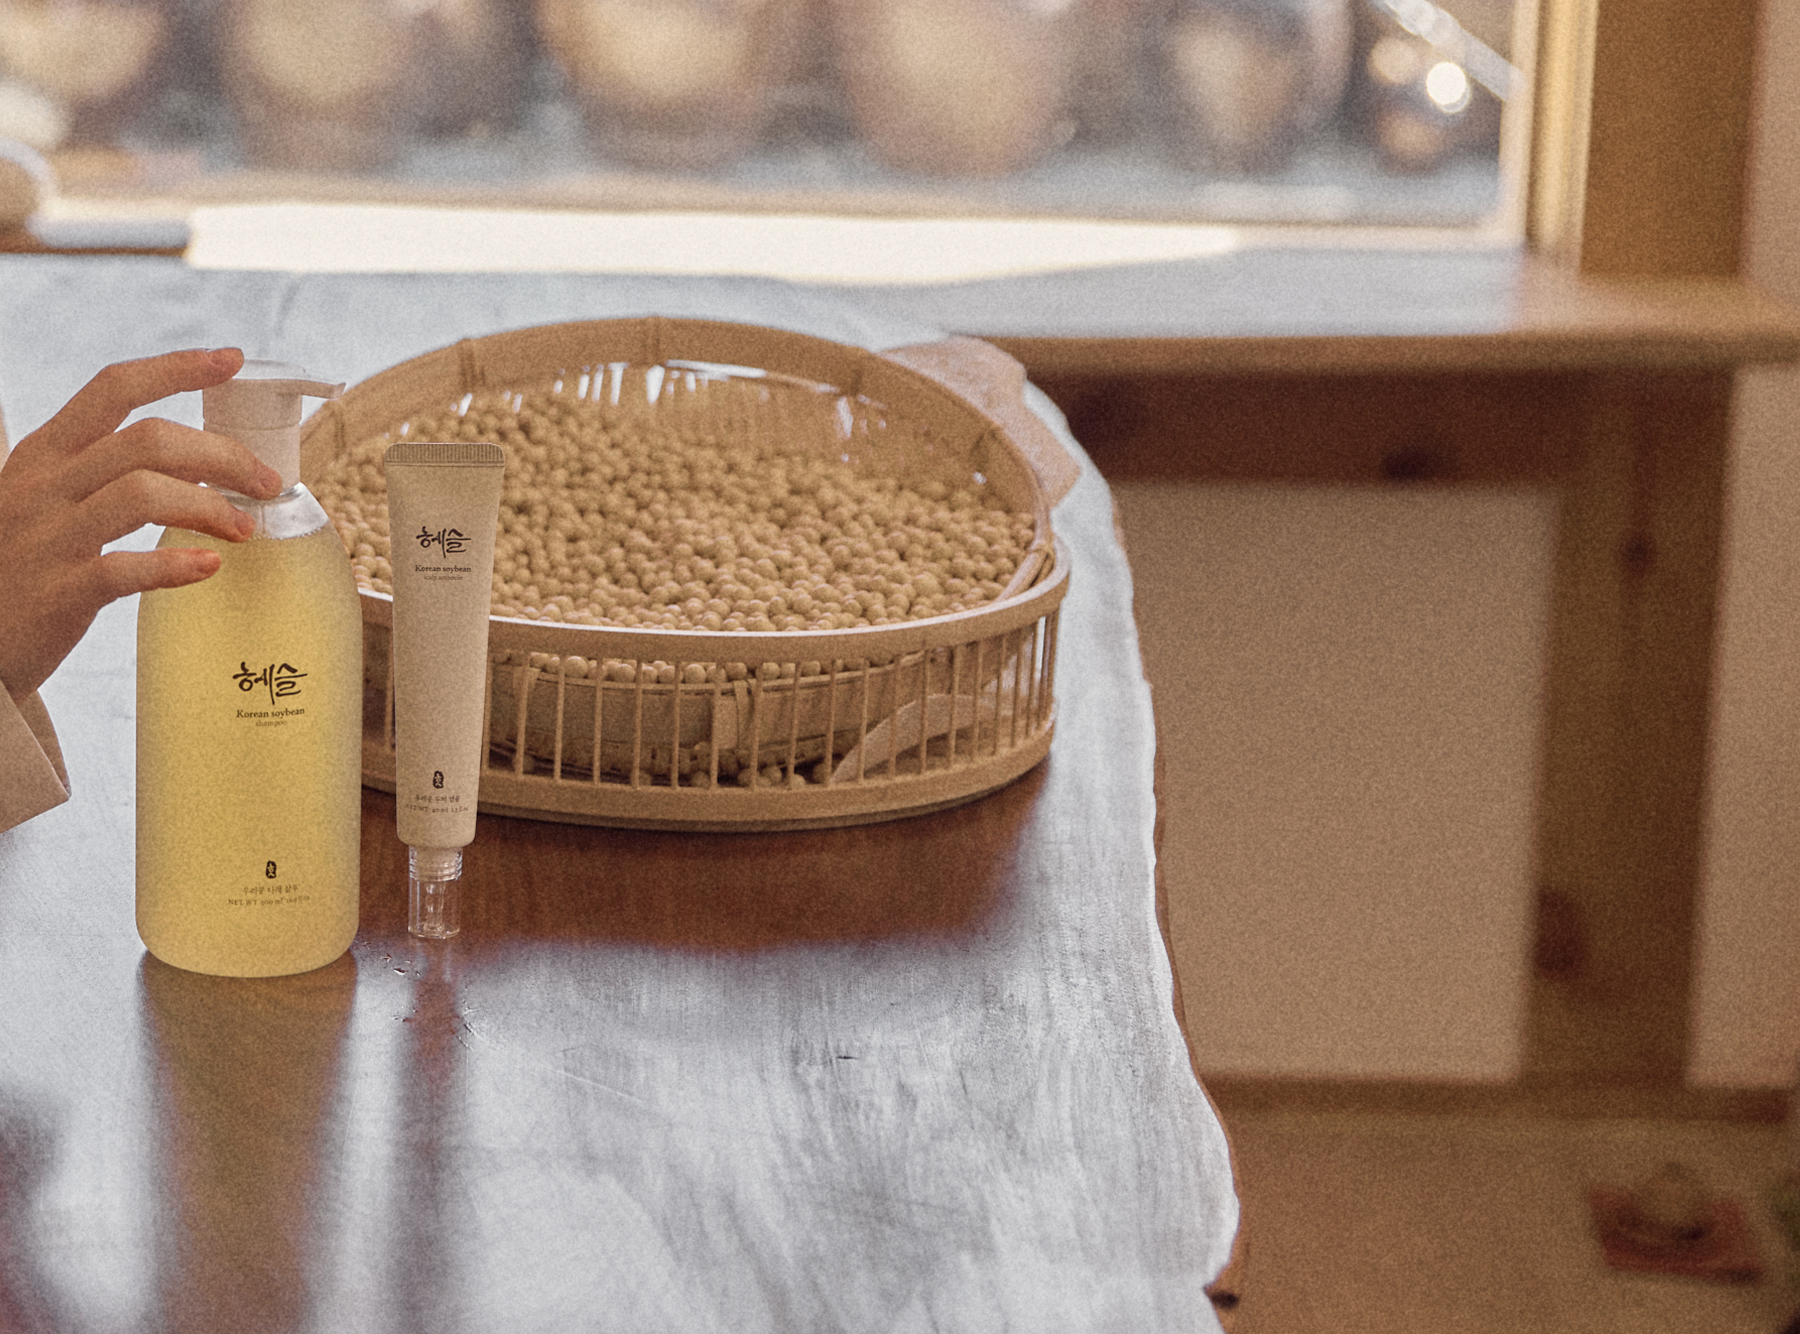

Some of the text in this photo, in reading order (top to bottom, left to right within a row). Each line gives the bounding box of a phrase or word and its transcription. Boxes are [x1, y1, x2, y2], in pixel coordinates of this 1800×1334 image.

[414, 564, 472, 574] Korean soybean
[438, 574, 463, 582] ampoule
[236, 707, 305, 719] Korean soybean
[255, 719, 287, 727] shampoo
[227, 898, 243, 906] NET
[245, 898, 258, 906] WT
